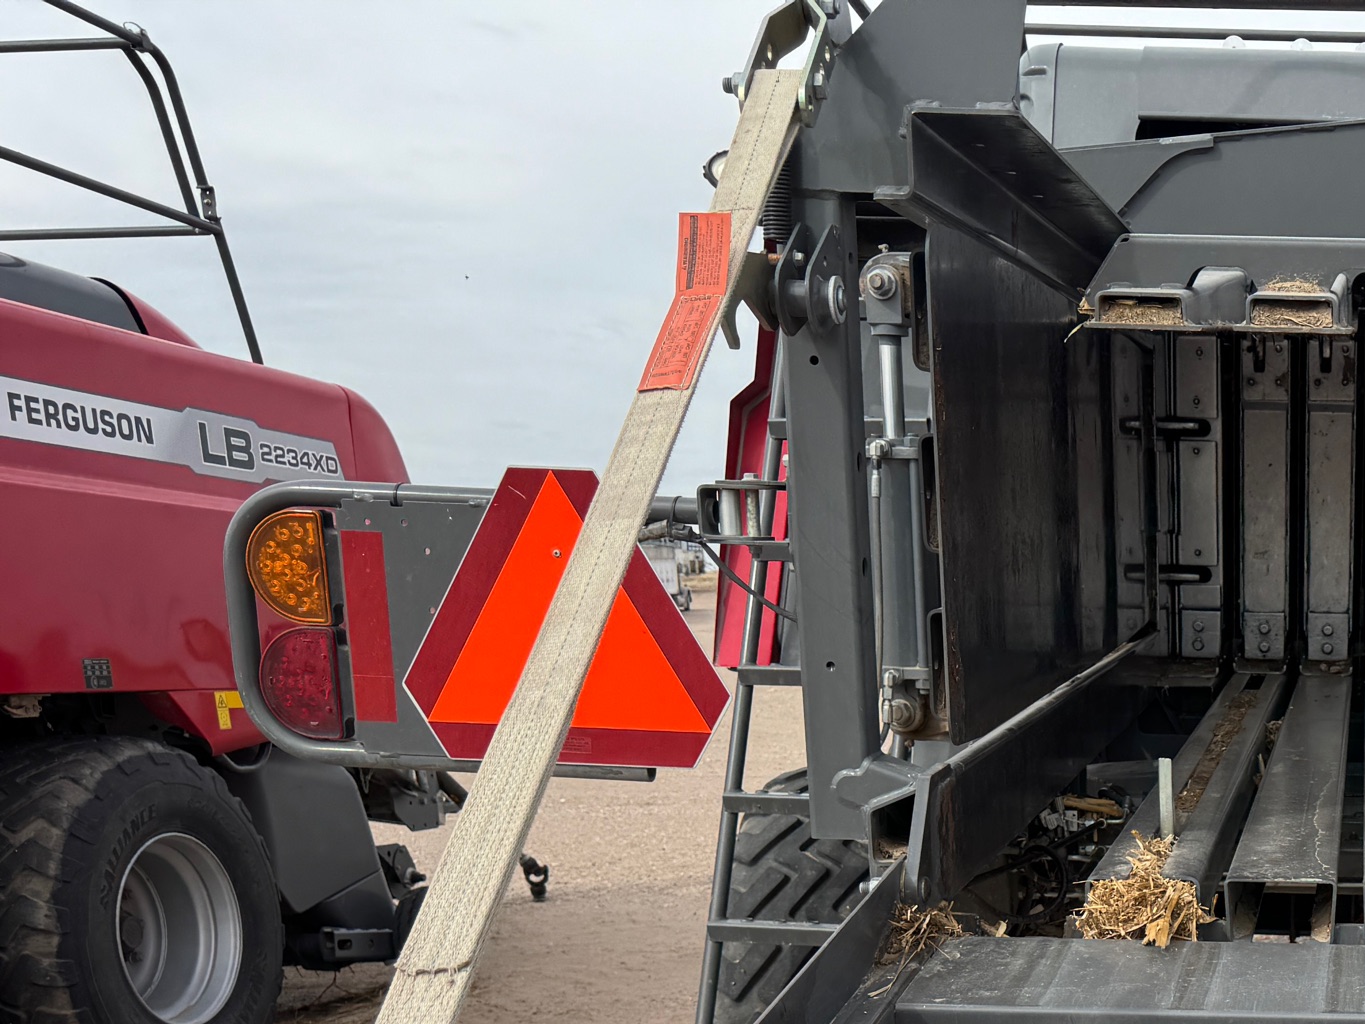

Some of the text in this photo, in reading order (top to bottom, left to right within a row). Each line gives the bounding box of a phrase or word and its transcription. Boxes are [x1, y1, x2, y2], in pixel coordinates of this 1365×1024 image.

[7, 391, 339, 475] FERGUSON LB 2234XD
[103, 803, 156, 891] ALLIANCE
